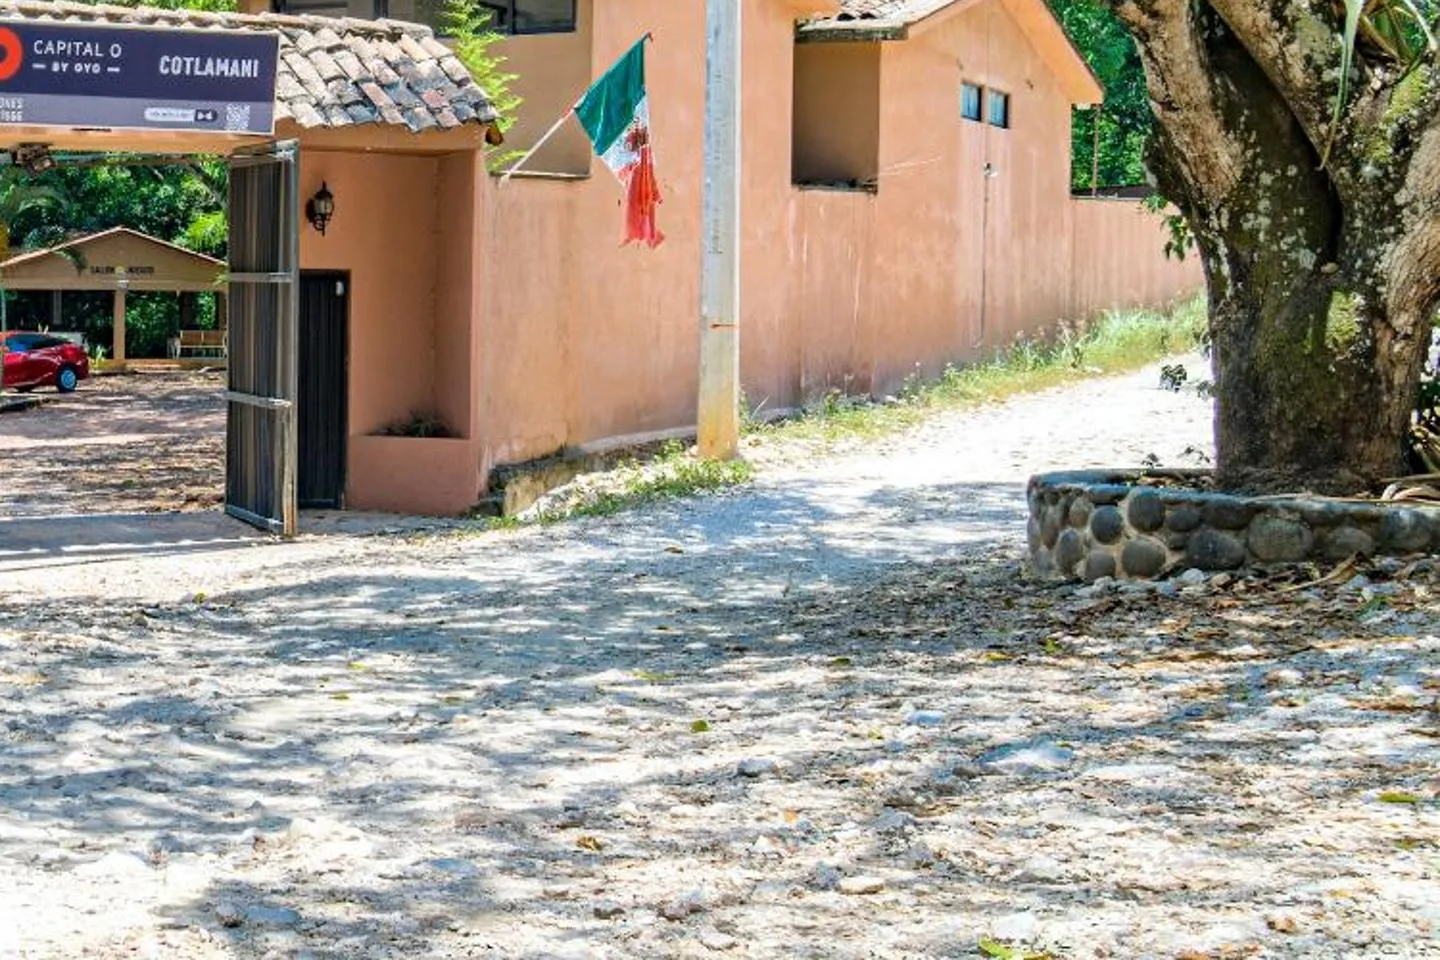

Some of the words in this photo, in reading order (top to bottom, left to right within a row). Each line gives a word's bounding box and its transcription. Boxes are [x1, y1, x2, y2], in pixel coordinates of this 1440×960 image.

[33, 40, 104, 56] CAPITAL
[110, 43, 122, 58] O
[52, 61, 68, 72] BY
[74, 62, 101, 74] OYO
[159, 55, 259, 78] COTLAMANI
